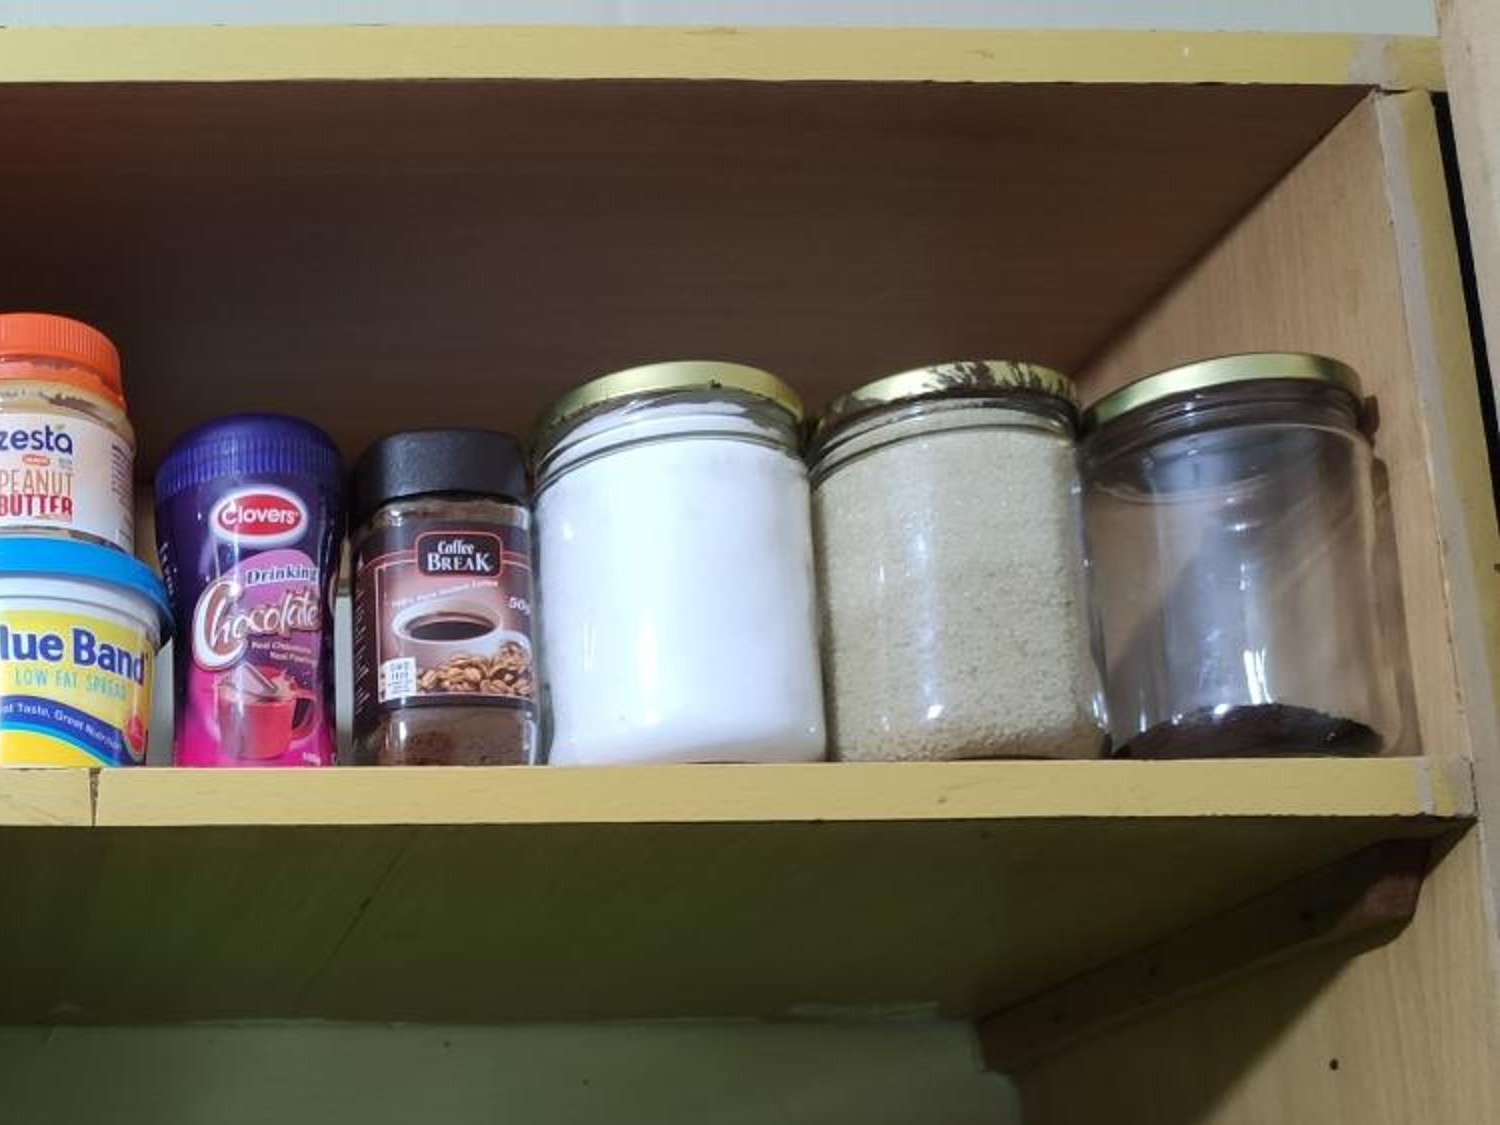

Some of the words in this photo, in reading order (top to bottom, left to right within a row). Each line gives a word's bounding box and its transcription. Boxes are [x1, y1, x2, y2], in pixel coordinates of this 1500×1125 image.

[221, 501, 297, 525] Clovers
[437, 540, 475, 555] Coffee
[247, 564, 318, 586] Drinking
[192, 580, 321, 668] Chocolate
[72, 628, 145, 686] Band
[15, 668, 47, 687] LOW
